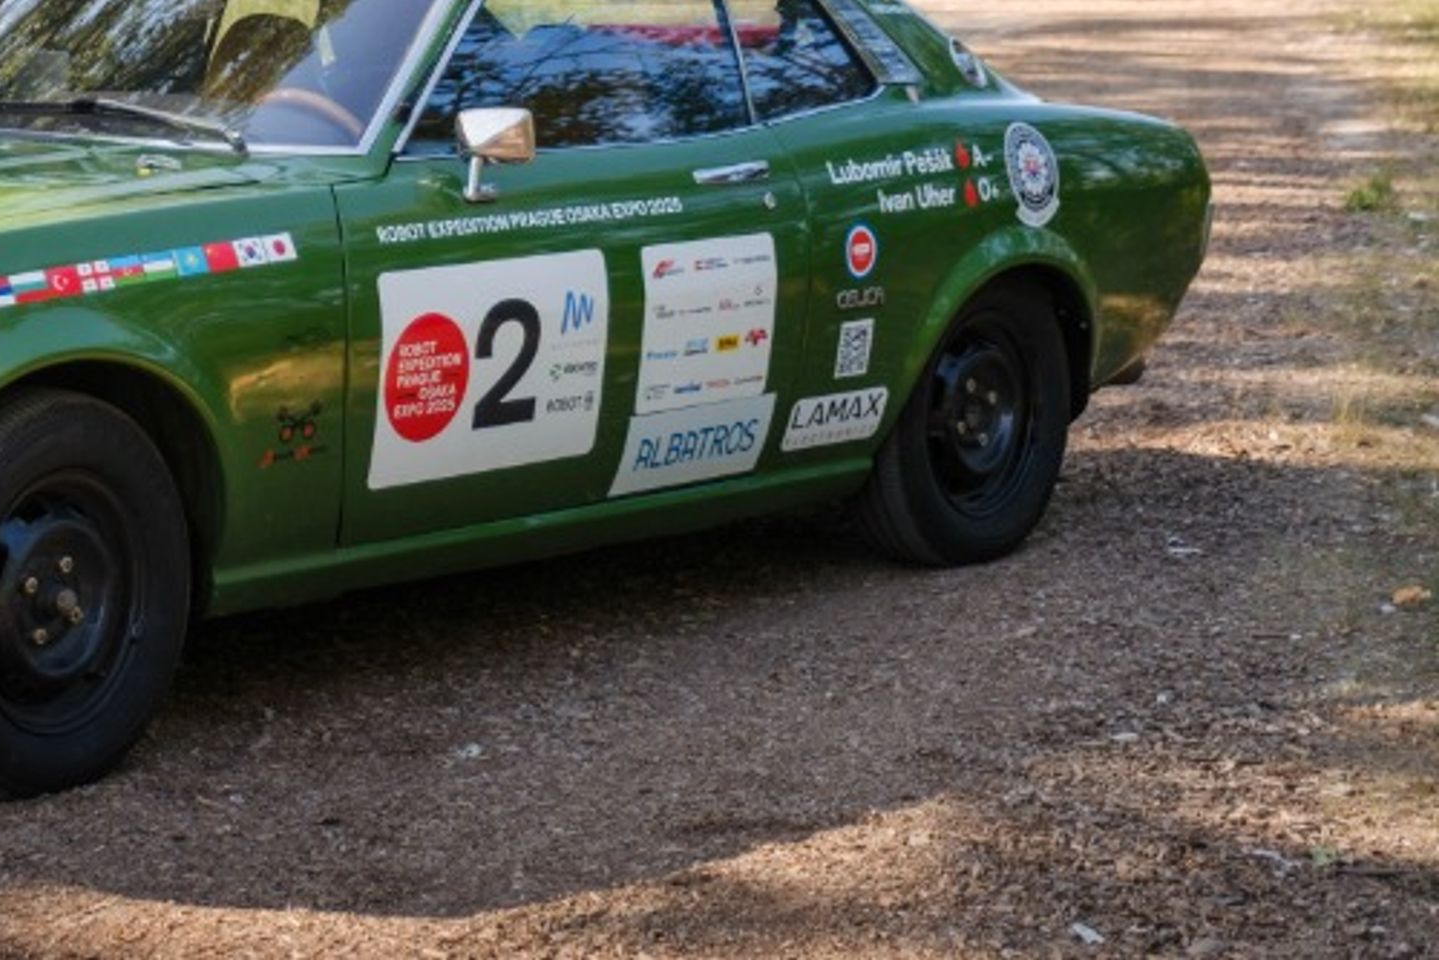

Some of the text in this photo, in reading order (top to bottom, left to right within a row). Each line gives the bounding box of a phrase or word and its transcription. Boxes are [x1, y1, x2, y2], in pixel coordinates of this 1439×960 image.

[876, 189, 914, 213] Ivan
[915, 181, 956, 208] Uher
[376, 195, 683, 244] ROBOT EXPEDITION PRAGUE OSAKA EXPO 2025
[398, 341, 438, 358] ROBOT
[397, 353, 463, 373] EXPEDITION
[471, 297, 542, 431] 2
[396, 370, 442, 389] PRAGUE
[418, 383, 456, 400] OSAKA
[393, 402, 424, 419] EXPO
[791, 390, 884, 430] LAMAX
[633, 419, 759, 471] ALBATROS
